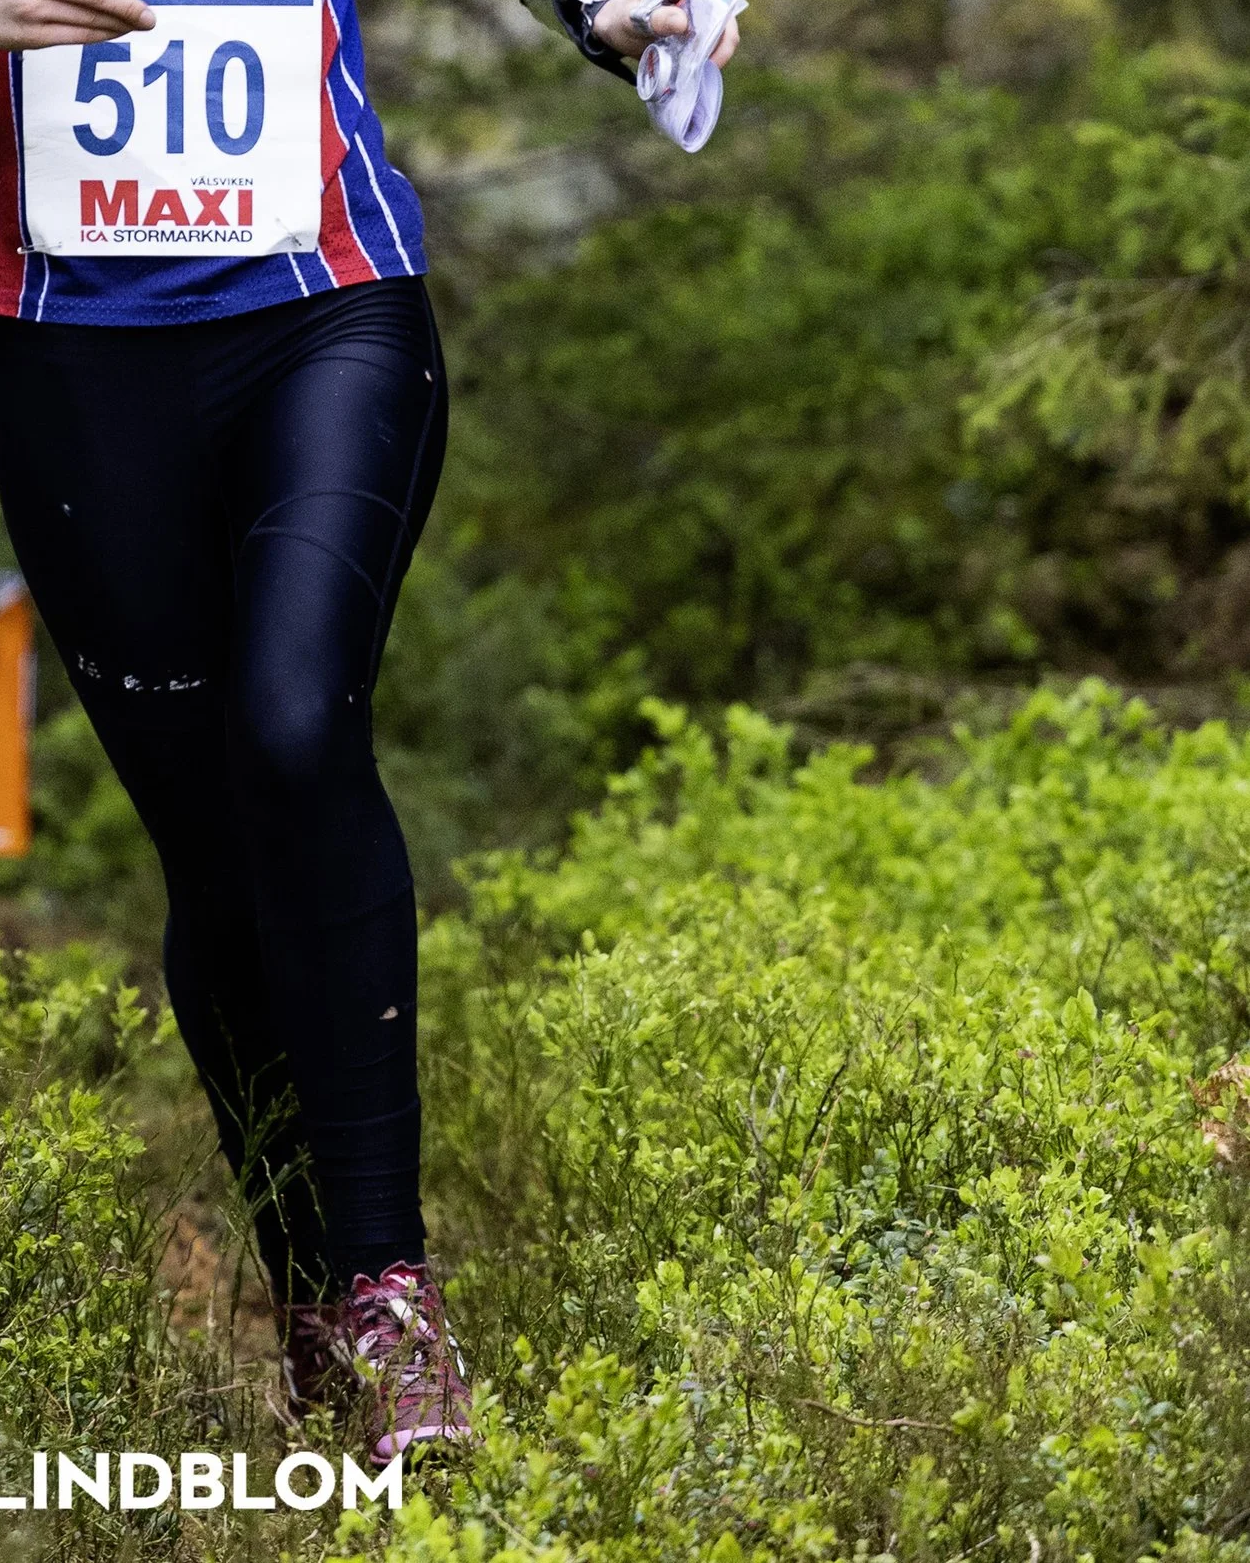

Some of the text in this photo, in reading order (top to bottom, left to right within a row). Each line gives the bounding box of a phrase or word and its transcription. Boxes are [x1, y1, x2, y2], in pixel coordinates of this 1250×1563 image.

[72, 39, 265, 156] 510
[190, 175, 254, 186] VÄLSVIKEN
[79, 179, 253, 226] MAXI
[80, 229, 253, 242] ICA STORMARKNAD
